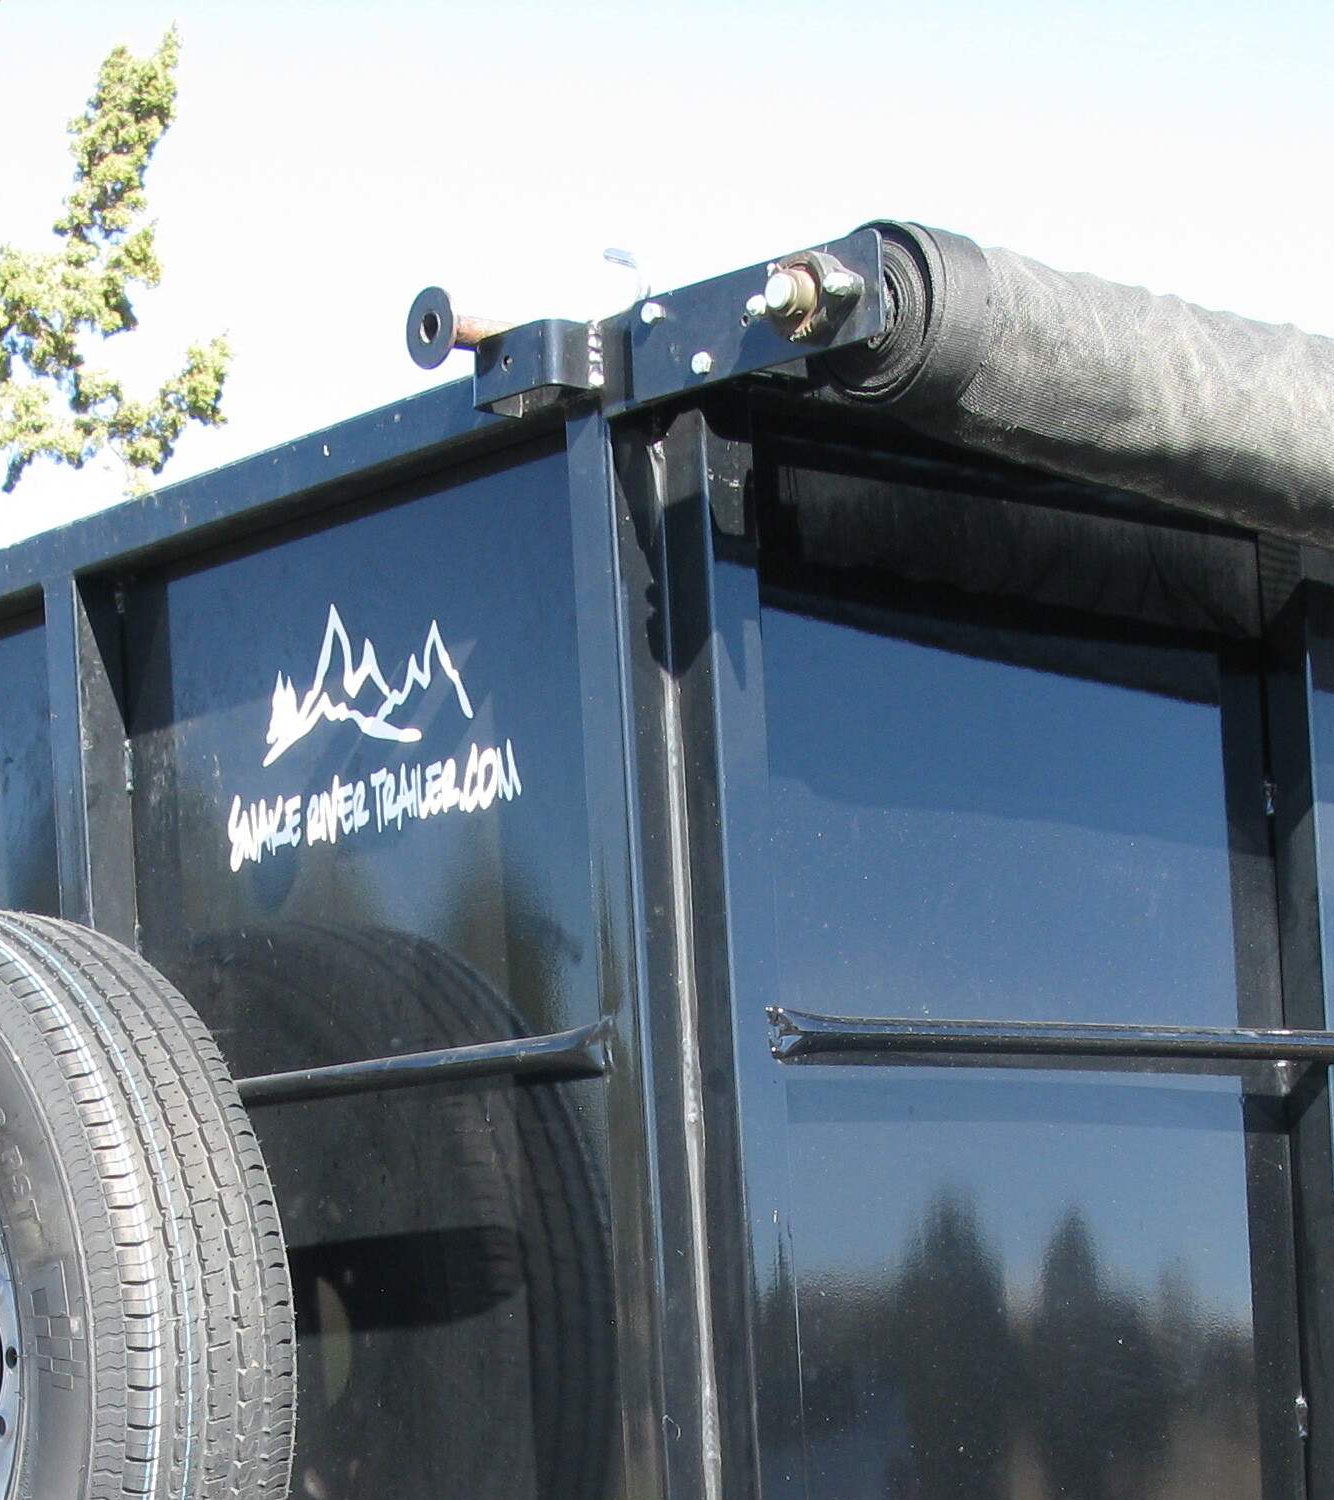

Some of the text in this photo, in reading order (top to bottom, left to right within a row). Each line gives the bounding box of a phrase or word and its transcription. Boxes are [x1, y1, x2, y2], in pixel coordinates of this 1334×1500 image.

[228, 739, 522, 872] SNAKE RIVER TRAILER.COM
